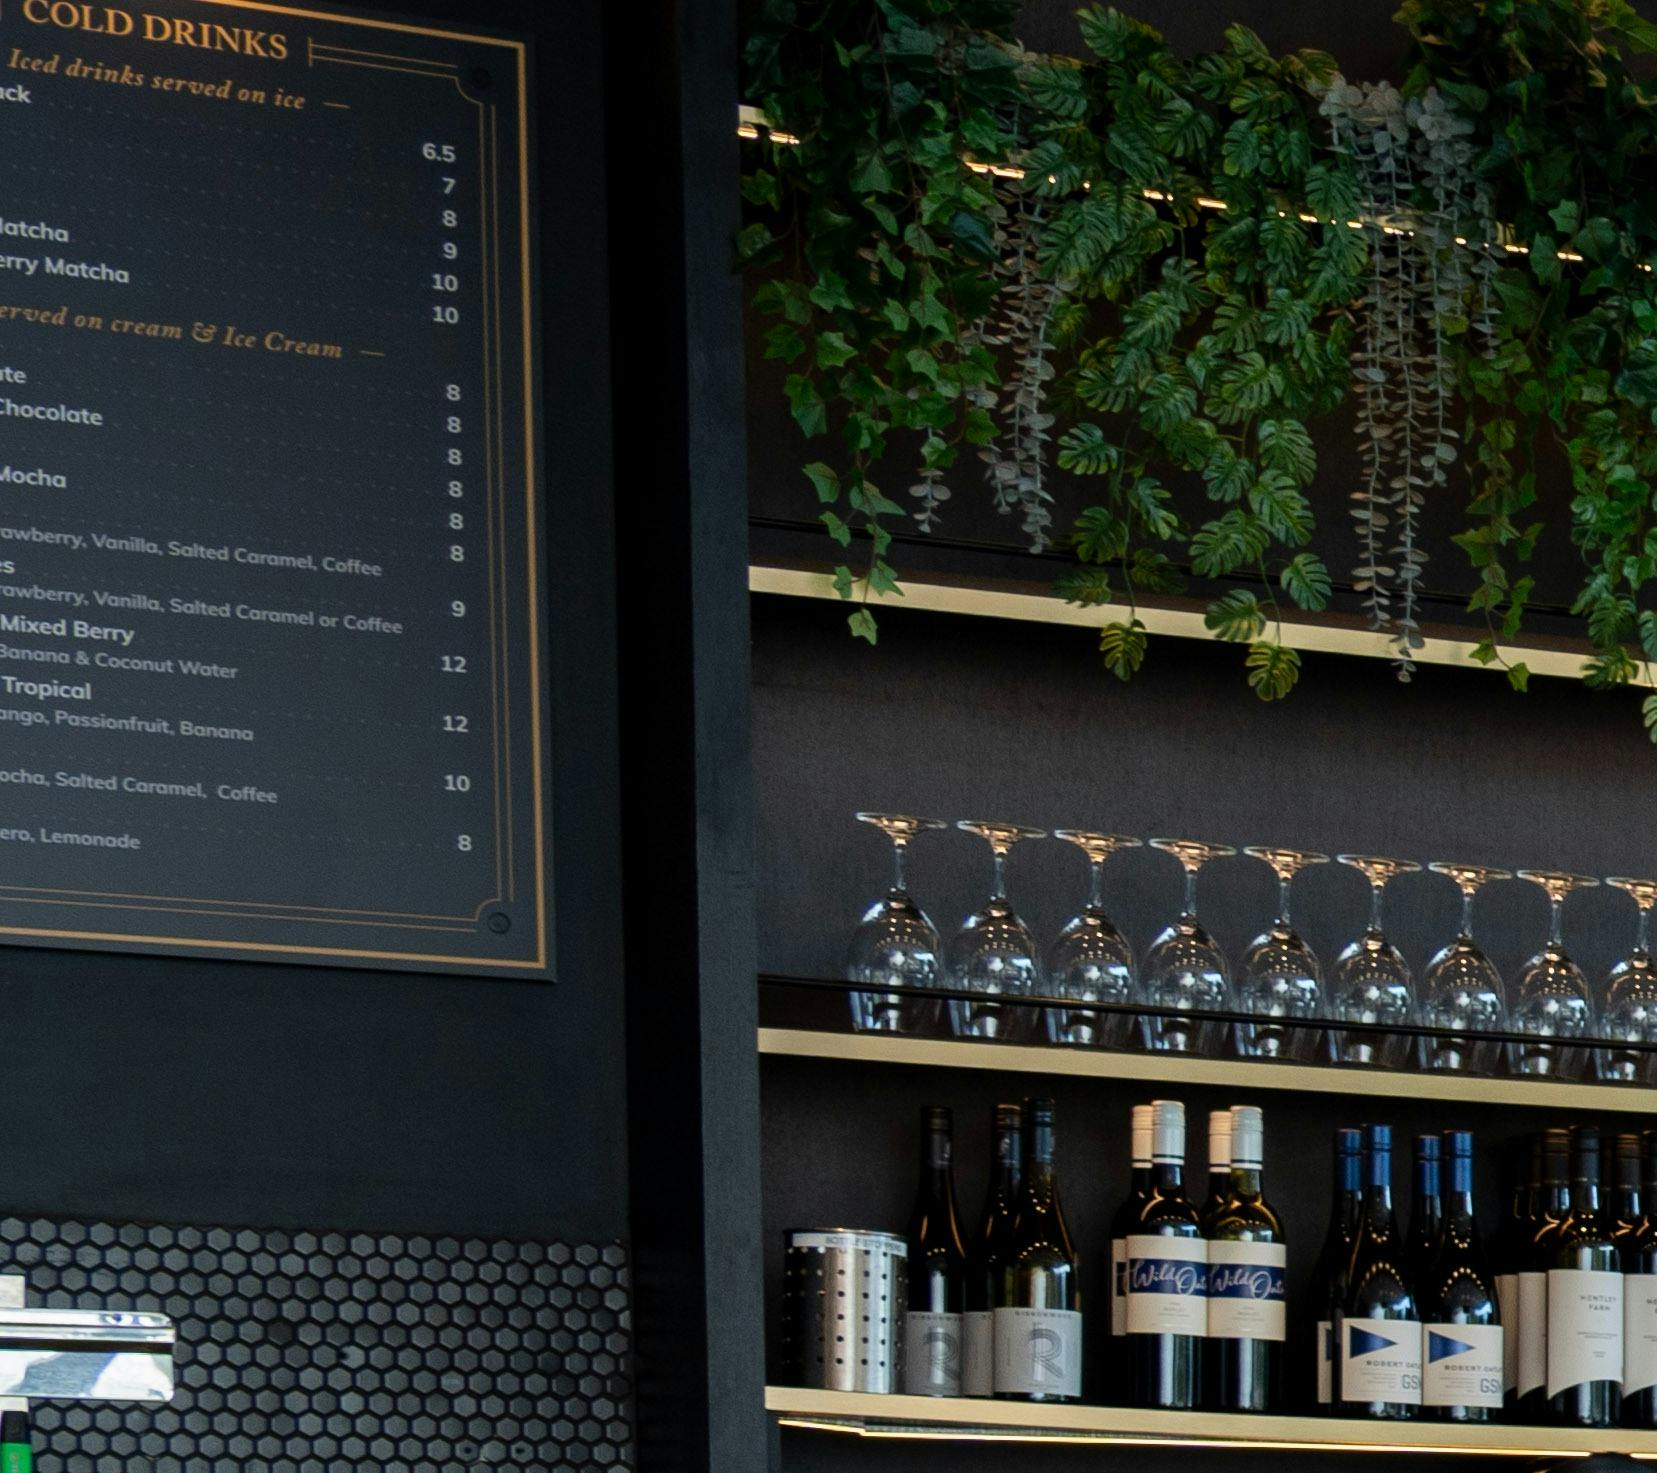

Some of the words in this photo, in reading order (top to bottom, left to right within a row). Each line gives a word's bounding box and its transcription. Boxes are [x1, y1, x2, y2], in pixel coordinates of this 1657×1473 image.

[24, 0, 133, 35] COLD
[143, 14, 286, 58] DRINKS
[9, 49, 59, 73] Iced
[65, 58, 143, 85] drinks
[152, 76, 232, 98] served
[237, 89, 265, 103] on
[275, 89, 305, 109] ice
[423, 143, 455, 162] 6.5
[442, 177, 455, 194] 7
[443, 210, 457, 227] 8
[443, 242, 457, 259] 9
[45, 257, 129, 283] Matcha
[432, 274, 457, 291] 10
[433, 306, 458, 323] 10
[75, 316, 102, 329] on
[111, 320, 182, 338] cream
[192, 322, 216, 342] &
[223, 326, 256, 347] Ice
[265, 332, 341, 358] Cream
[446, 385, 460, 401] 8
[447, 416, 461, 433] 8
[448, 449, 462, 465] 8
[449, 481, 462, 497] 8
[449, 513, 463, 529] 8
[91, 533, 163, 555] Vanilla,
[168, 541, 229, 560] Salted
[234, 548, 317, 570] Caramel,
[323, 557, 382, 576] Coffee
[450, 545, 464, 561] 8
[93, 591, 164, 612] Vanilla,
[170, 598, 231, 617] Salted
[236, 605, 314, 625] Caramel
[319, 616, 339, 627] or
[343, 615, 402, 633] Coffee
[452, 601, 465, 617] 9
[1, 614, 66, 636] Mixed
[74, 621, 134, 645] Berry
[76, 651, 89, 665] &
[95, 653, 173, 673] Coconut
[178, 660, 237, 678] Water
[442, 656, 466, 673] 12
[1, 676, 91, 700] Tropical
[55, 710, 174, 735] Passionfruit,
[180, 721, 253, 740] Banana
[444, 716, 468, 732] 12
[55, 772, 117, 790] Salted
[122, 777, 207, 798] Caramel,
[217, 785, 277, 803] Coffee
[445, 775, 470, 791] 10
[40, 828, 140, 849] Lemonade
[458, 835, 471, 851] 8
